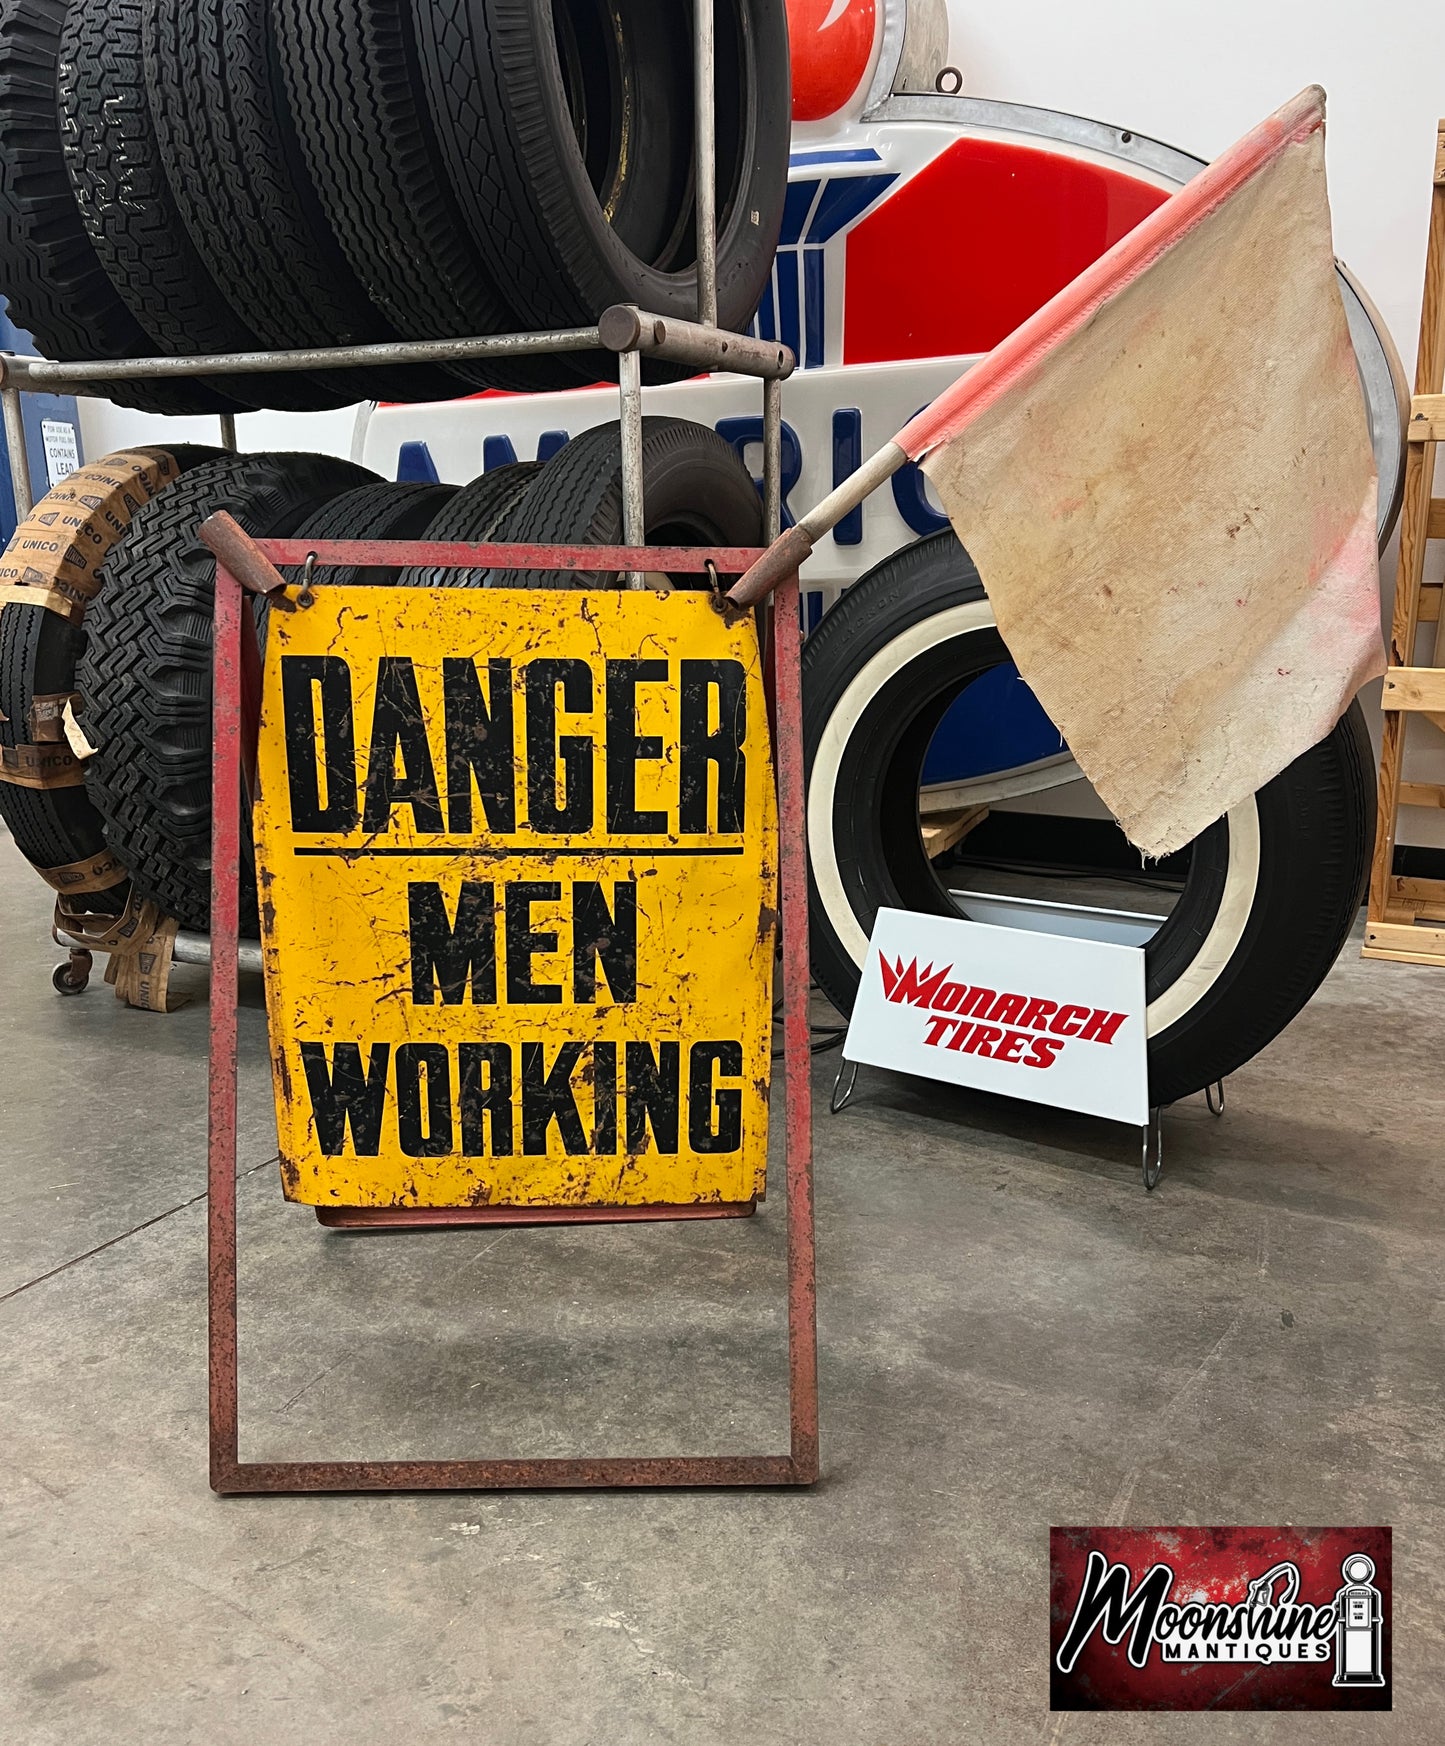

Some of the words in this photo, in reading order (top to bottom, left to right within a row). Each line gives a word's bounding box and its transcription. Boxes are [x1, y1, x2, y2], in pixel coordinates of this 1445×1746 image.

[49, 448, 75, 459] CONTAINS
[56, 462, 75, 475] LEAD
[84, 474, 123, 490] UNICO
[22, 539, 59, 552] UNICO
[281, 655, 747, 835] DANGER
[408, 881, 638, 1005] MEN
[879, 948, 1130, 1045] MONARCH
[923, 1015, 1065, 1068] TIRES
[300, 1040, 744, 1157] WORKING
